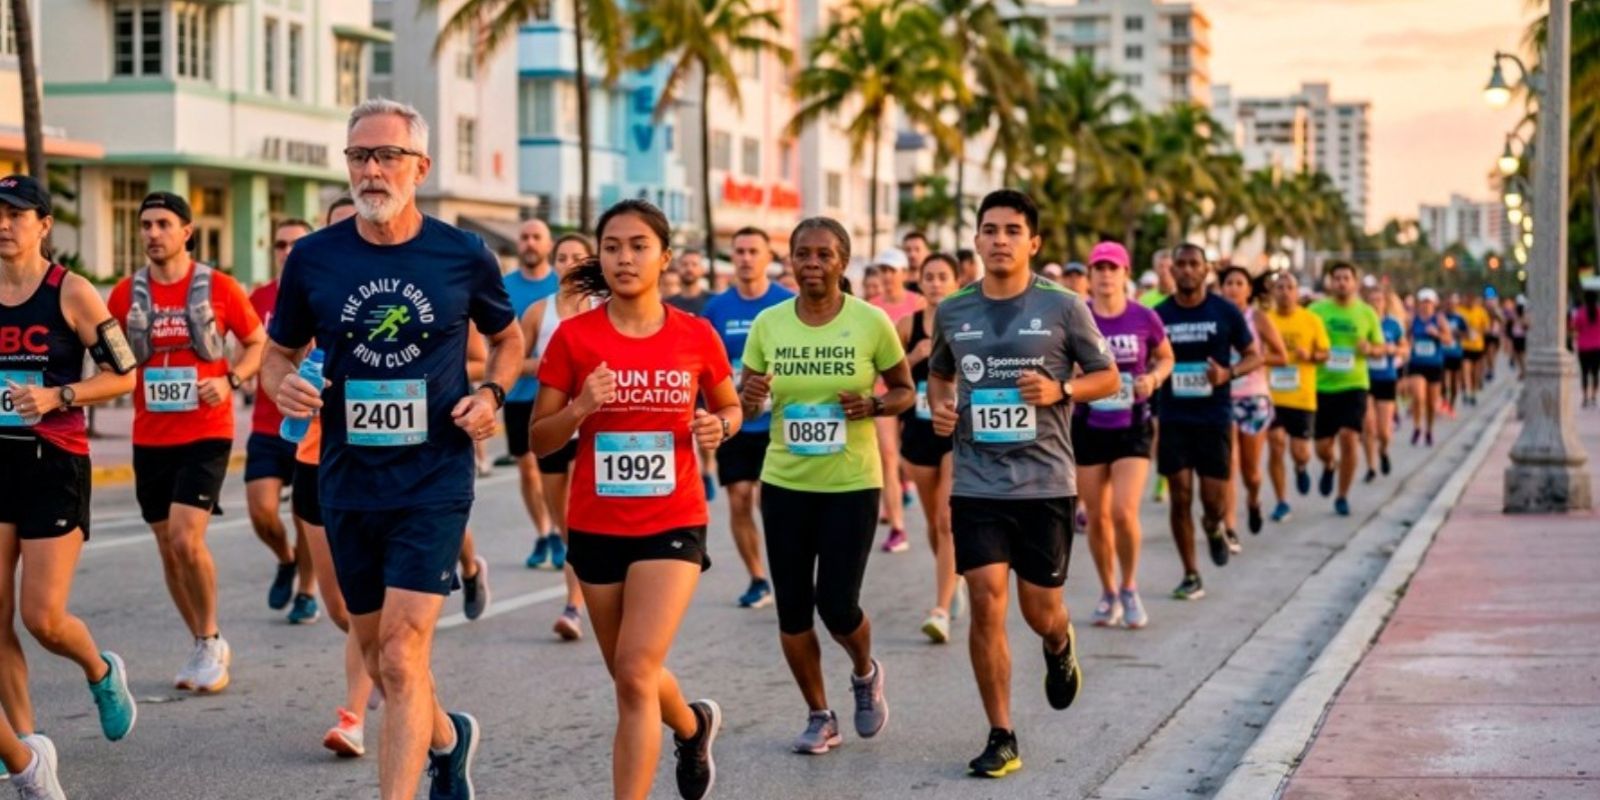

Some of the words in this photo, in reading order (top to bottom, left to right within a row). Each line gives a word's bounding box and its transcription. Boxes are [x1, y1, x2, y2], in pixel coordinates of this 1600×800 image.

[341, 294, 362, 322] THE
[358, 279, 400, 299] DAILY
[402, 283, 434, 323] GRIND
[353, 343, 381, 367] RUN
[386, 343, 421, 368] CLUB
[775, 346, 811, 359] MILE
[815, 346, 855, 359] HIGH
[986, 356, 1045, 369] Sponsored
[612, 370, 649, 387] UN
[655, 370, 692, 387] FOR
[774, 361, 856, 376] RUNNERS
[148, 382, 192, 401] 1987
[352, 402, 414, 430] 2401
[977, 407, 1028, 429] 1512
[789, 422, 839, 442] 0887
[603, 454, 666, 481] 1992
